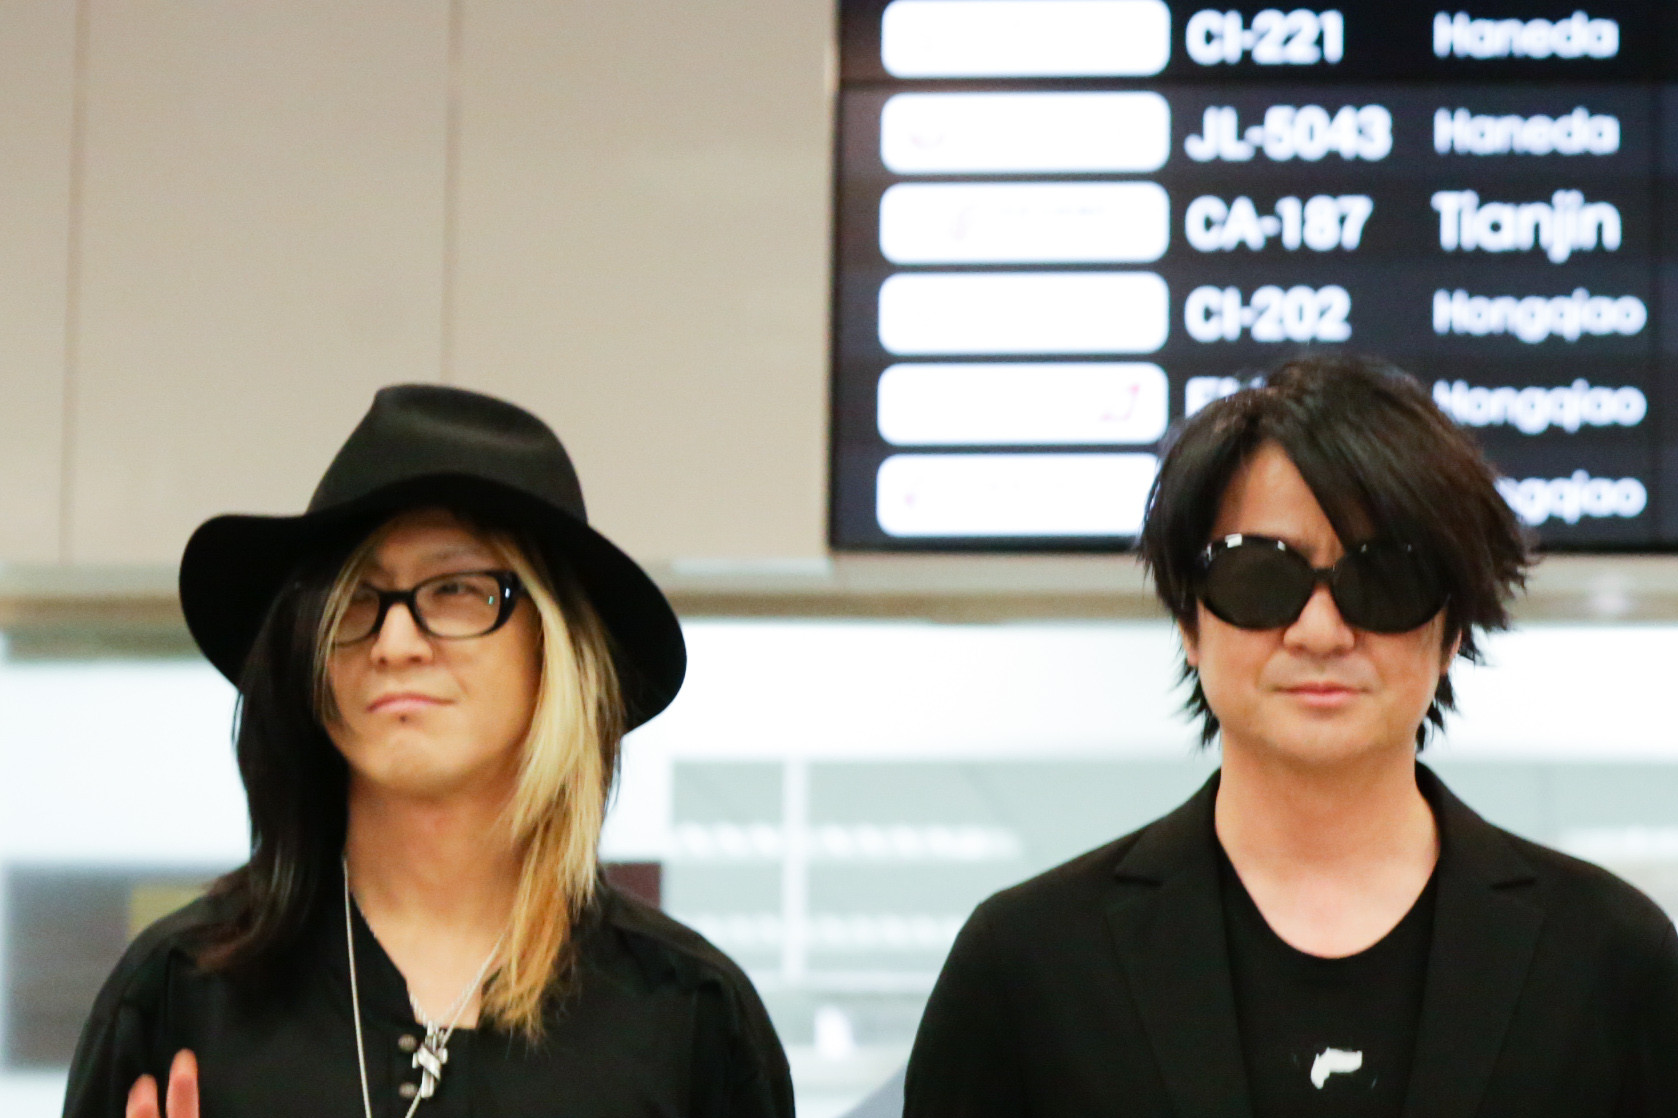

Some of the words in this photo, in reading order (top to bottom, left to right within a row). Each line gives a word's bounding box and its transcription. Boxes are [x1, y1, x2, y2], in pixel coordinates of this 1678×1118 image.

[1186, 10, 1343, 64] CI-221
[1434, 11, 1618, 57] Haneda
[1185, 106, 1392, 161] JL-5043
[1434, 108, 1619, 154] Haneda
[1185, 196, 1372, 251] CA-187
[1432, 191, 1620, 262] Tianjin
[1185, 286, 1350, 341] CI-202
[1433, 289, 1646, 342] Hongqiao
[1433, 380, 1646, 433] Hongqiao
[1496, 470, 1646, 525] gqiao
